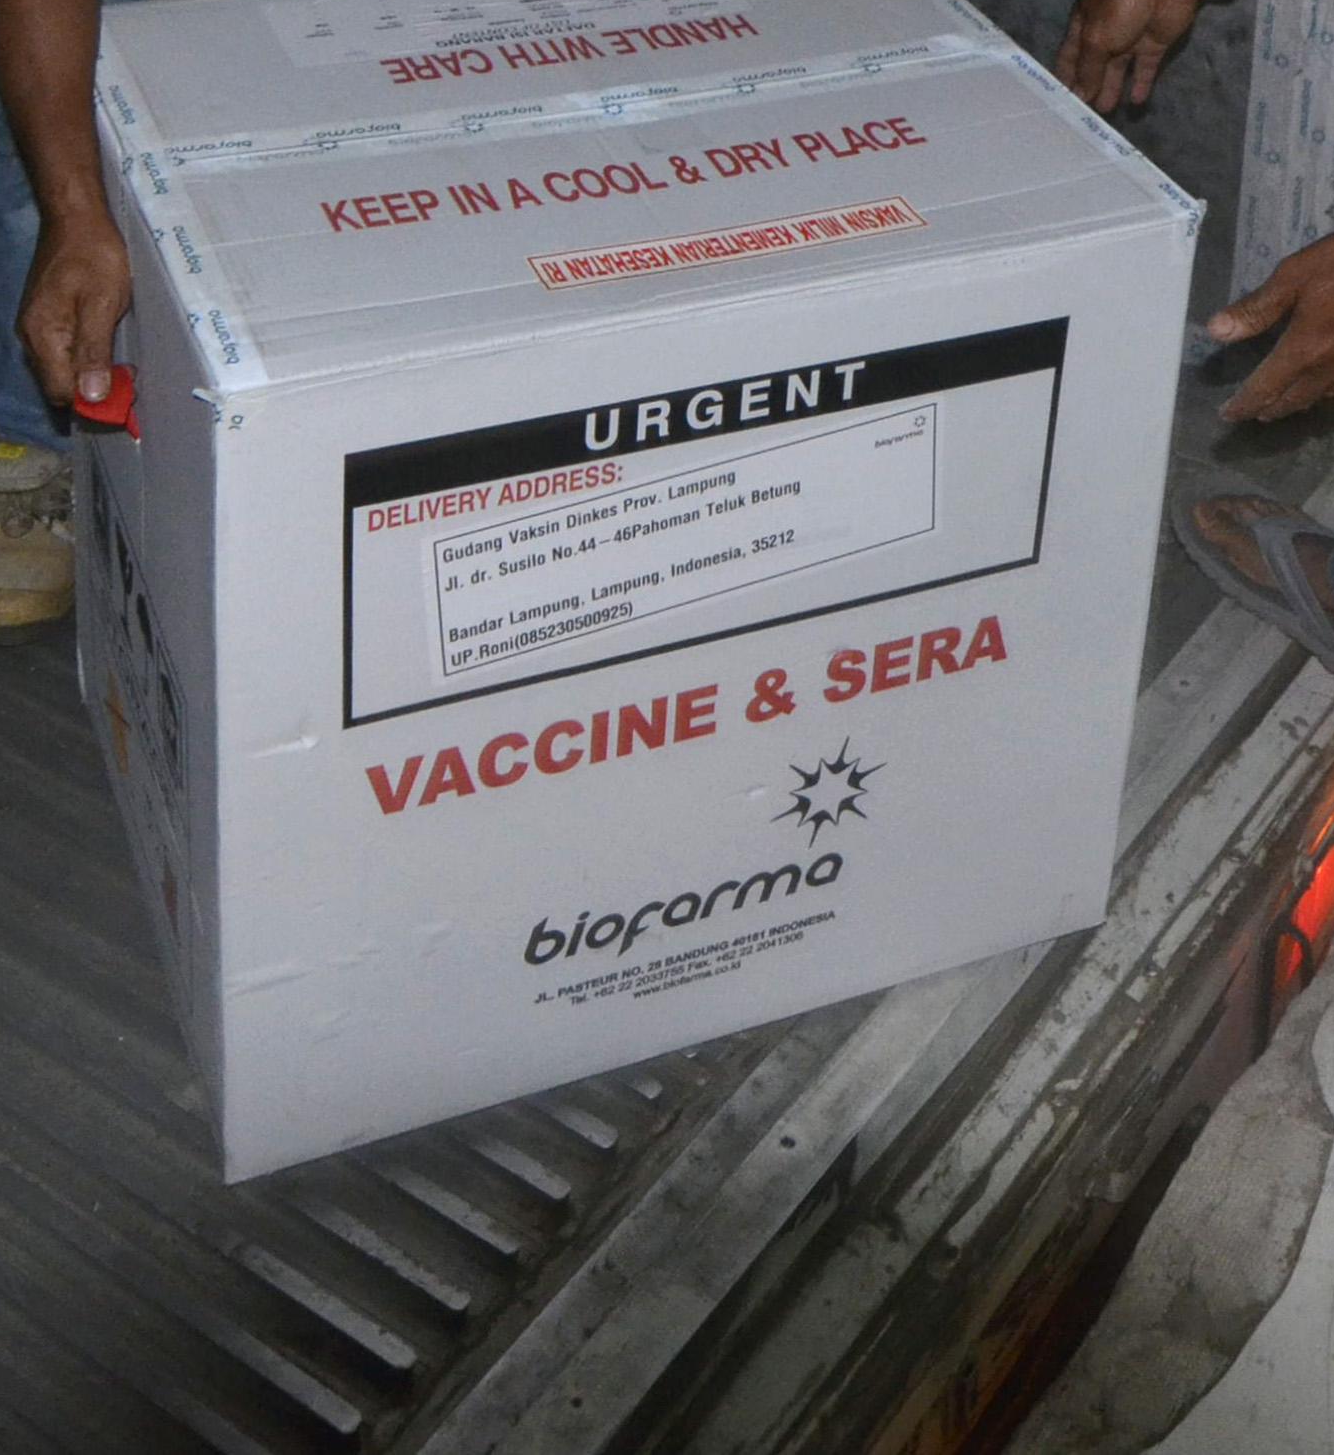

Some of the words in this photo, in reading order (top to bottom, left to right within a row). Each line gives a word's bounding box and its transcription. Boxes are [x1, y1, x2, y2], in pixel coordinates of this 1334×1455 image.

[497, 35, 606, 69] WITH
[601, 14, 759, 56] HANDLE
[379, 48, 494, 84] CARE
[314, 122, 402, 139] biofarma
[460, 105, 544, 123] biofarma
[140, 150, 168, 196] biofarma
[320, 189, 440, 233] KEEP
[447, 182, 501, 216] IN
[507, 178, 543, 209] A
[542, 161, 669, 202] COOL
[668, 155, 708, 185] &
[703, 138, 790, 178] DRY
[791, 117, 928, 163] PLACE
[790, 216, 849, 242] MILIK
[840, 204, 913, 232] VAKSIN
[172, 224, 203, 275] biofarma
[559, 245, 676, 282] KESEHATAN
[669, 225, 798, 264] KEMENTERIAN
[540, 261, 567, 284] RI
[207, 309, 241, 366] biofarma
[585, 360, 866, 451] URGENT
[368, 486, 492, 533] DELIVERY
[498, 461, 623, 506] ADDRESS:
[442, 537, 503, 564] Gudang
[508, 521, 560, 544] Vaksin
[566, 505, 618, 529] Dinkes
[623, 494, 662, 513] Prov.
[668, 471, 736, 500] Lampung
[444, 575, 464, 592] Jl.
[470, 569, 492, 585] dr.
[498, 553, 546, 577] Susilo
[706, 494, 746, 517] Teluk
[751, 480, 801, 505] Betung
[448, 617, 504, 643] Bandar
[509, 595, 585, 625] Lampung,
[591, 571, 665, 601] Lampung,
[670, 547, 746, 577] Indonesia,
[751, 529, 795, 554] 35212
[451, 601, 633, 667] UP.Roni(085230500925)
[366, 683, 719, 815] VACCINE
[745, 668, 797, 723] &
[823, 615, 1007, 703] SERA
[524, 852, 841, 966] biofarma
[534, 993, 555, 1004] JL.
[557, 973, 619, 998] PASTEUR
[621, 966, 645, 980] NO.
[648, 960, 663, 971] 28
[665, 942, 729, 966] BANDUNG
[769, 910, 836, 937] INDONESIA
[618, 982, 633, 992] 22
[739, 946, 754, 957] 22
